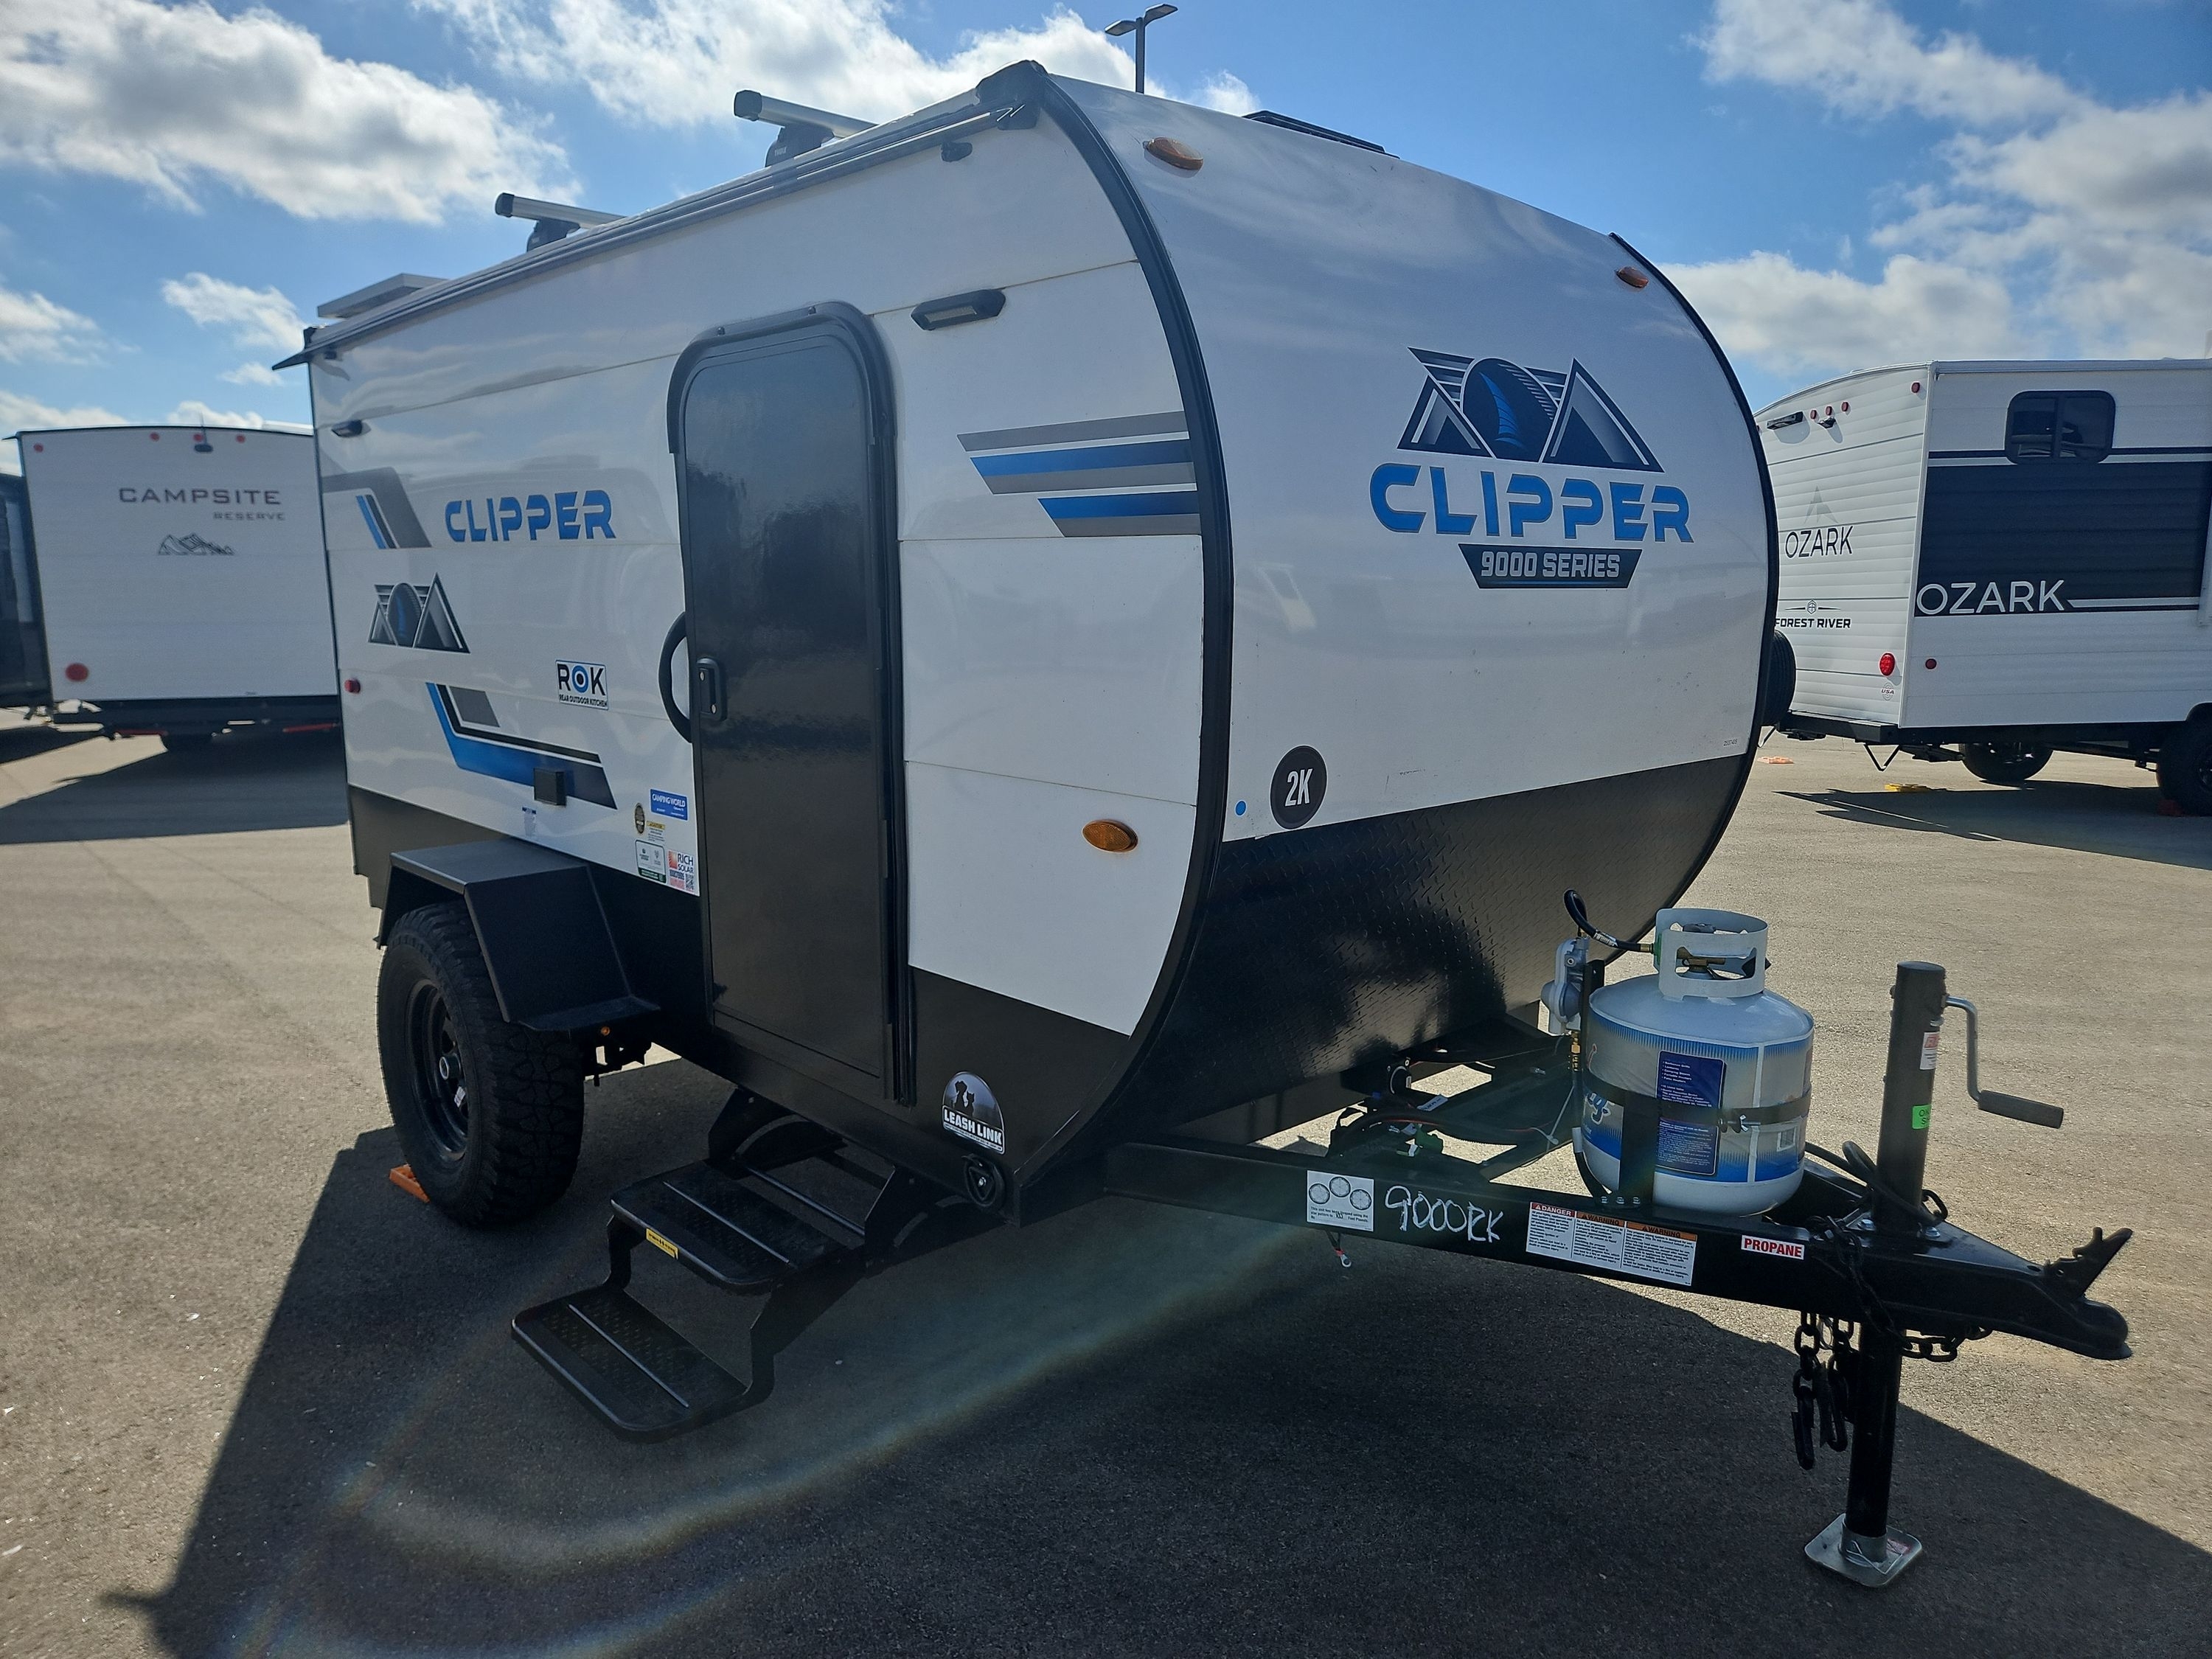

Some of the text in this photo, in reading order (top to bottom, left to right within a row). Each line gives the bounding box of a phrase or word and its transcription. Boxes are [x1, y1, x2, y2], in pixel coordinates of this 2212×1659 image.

[119, 487, 282, 505] CAMPSITE
[1369, 462, 1694, 543] CLIPPER
[212, 511, 285, 521] RESERVE
[445, 490, 616, 543] CLIPPER
[1785, 526, 1853, 558] OZARK
[1481, 551, 1620, 578] 9000 SERIES
[1916, 580, 2065, 615] OZARK
[1775, 618, 1851, 628] FOREST RIVER
[557, 663, 606, 696] ROK
[1284, 768, 1313, 807] 2K
[677, 853, 694, 866] RICH
[678, 863, 694, 873] SOLAR
[944, 1108, 975, 1134] LEASH
[977, 1123, 1002, 1145] LINK
[1542, 1205, 1572, 1216] DANGER
[1588, 1214, 1620, 1225] WARNING
[1648, 1225, 1681, 1237] WARNING
[1744, 1238, 1802, 1257] PROPANE
